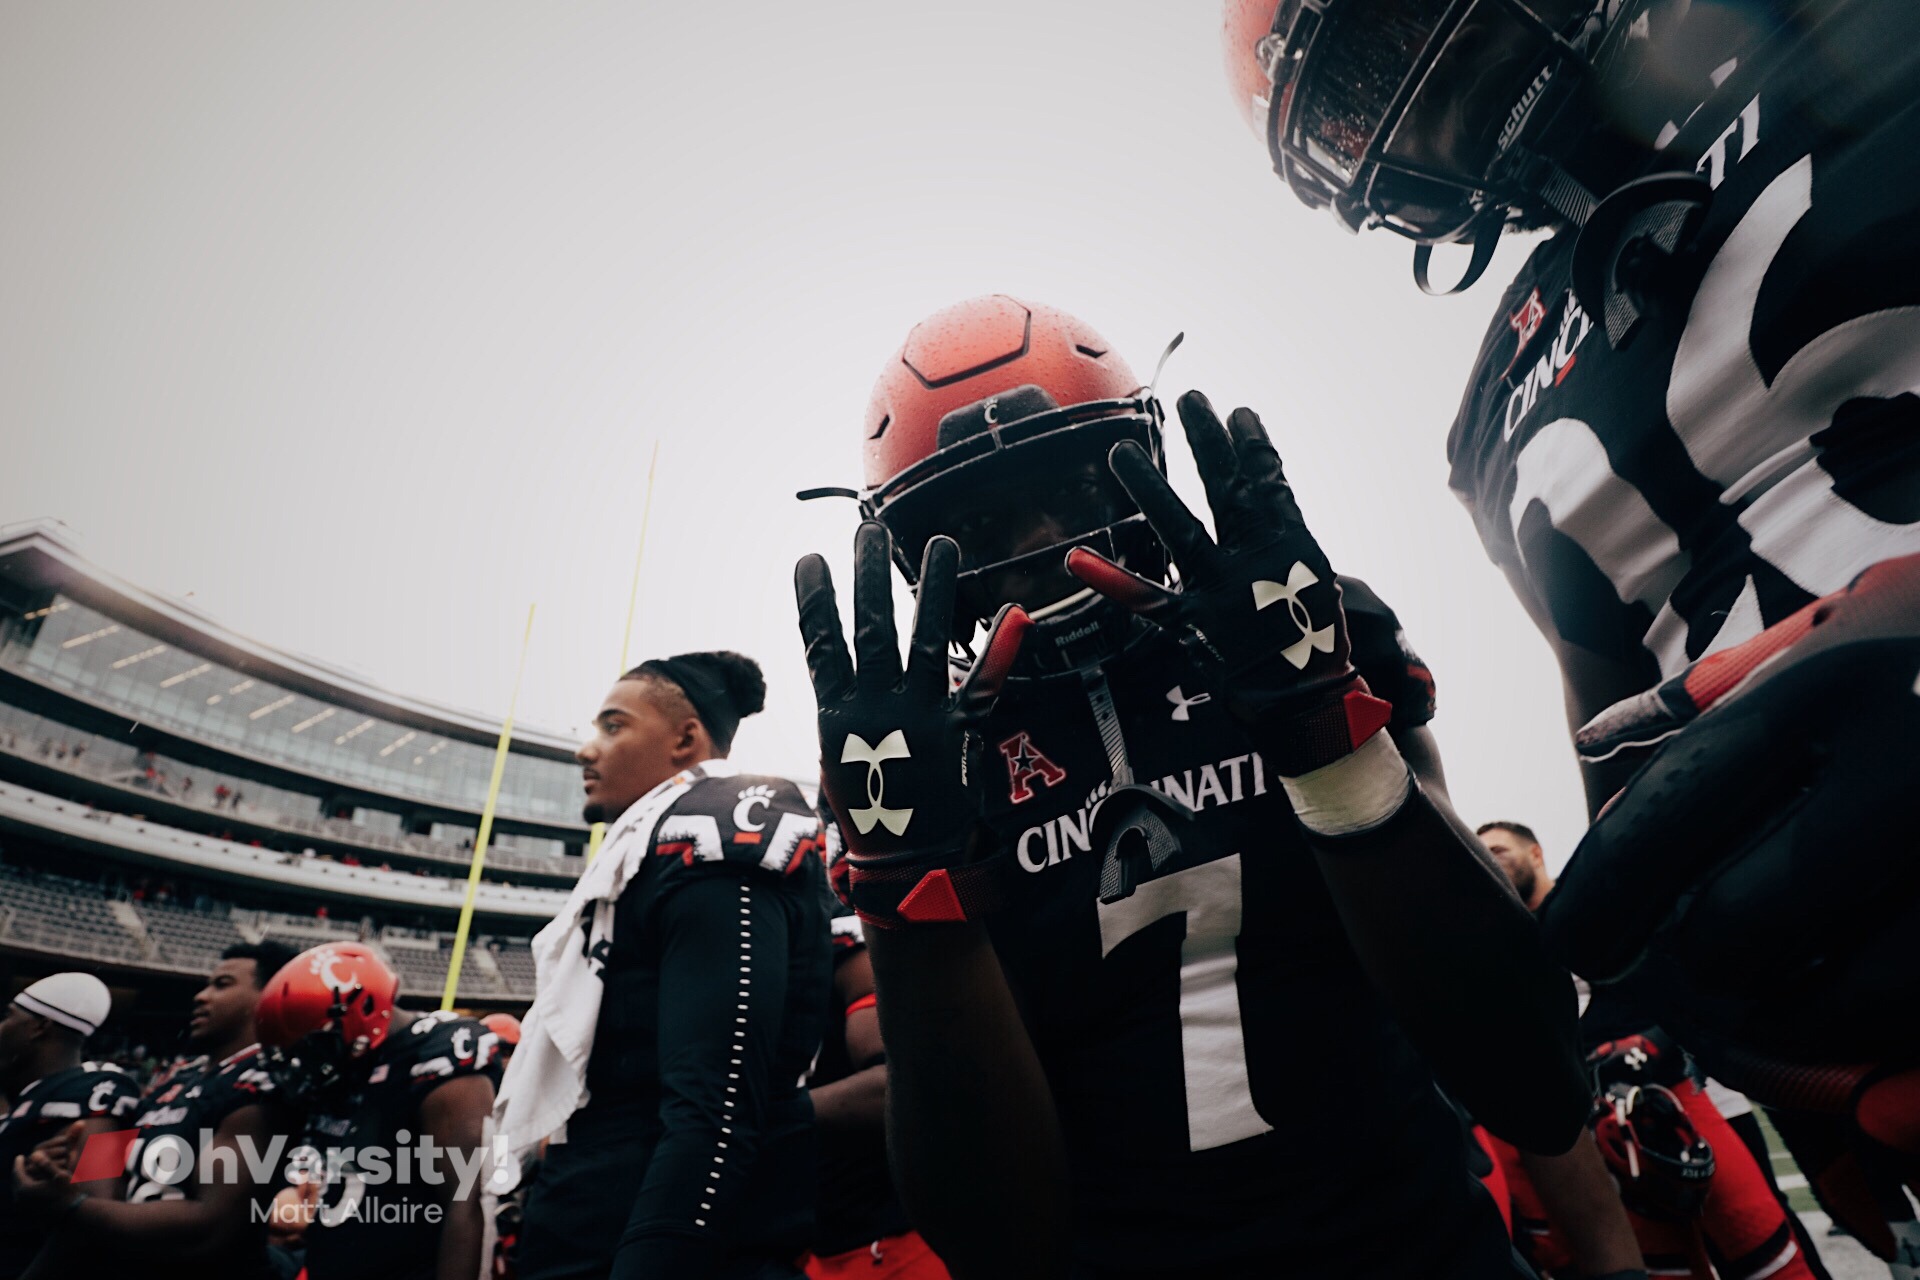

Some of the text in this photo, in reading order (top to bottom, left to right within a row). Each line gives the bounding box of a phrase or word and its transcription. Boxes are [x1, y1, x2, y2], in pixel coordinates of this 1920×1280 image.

[1055, 620, 1100, 647] Riddell
[732, 790, 774, 833] C
[1096, 851, 1275, 1153] 7
